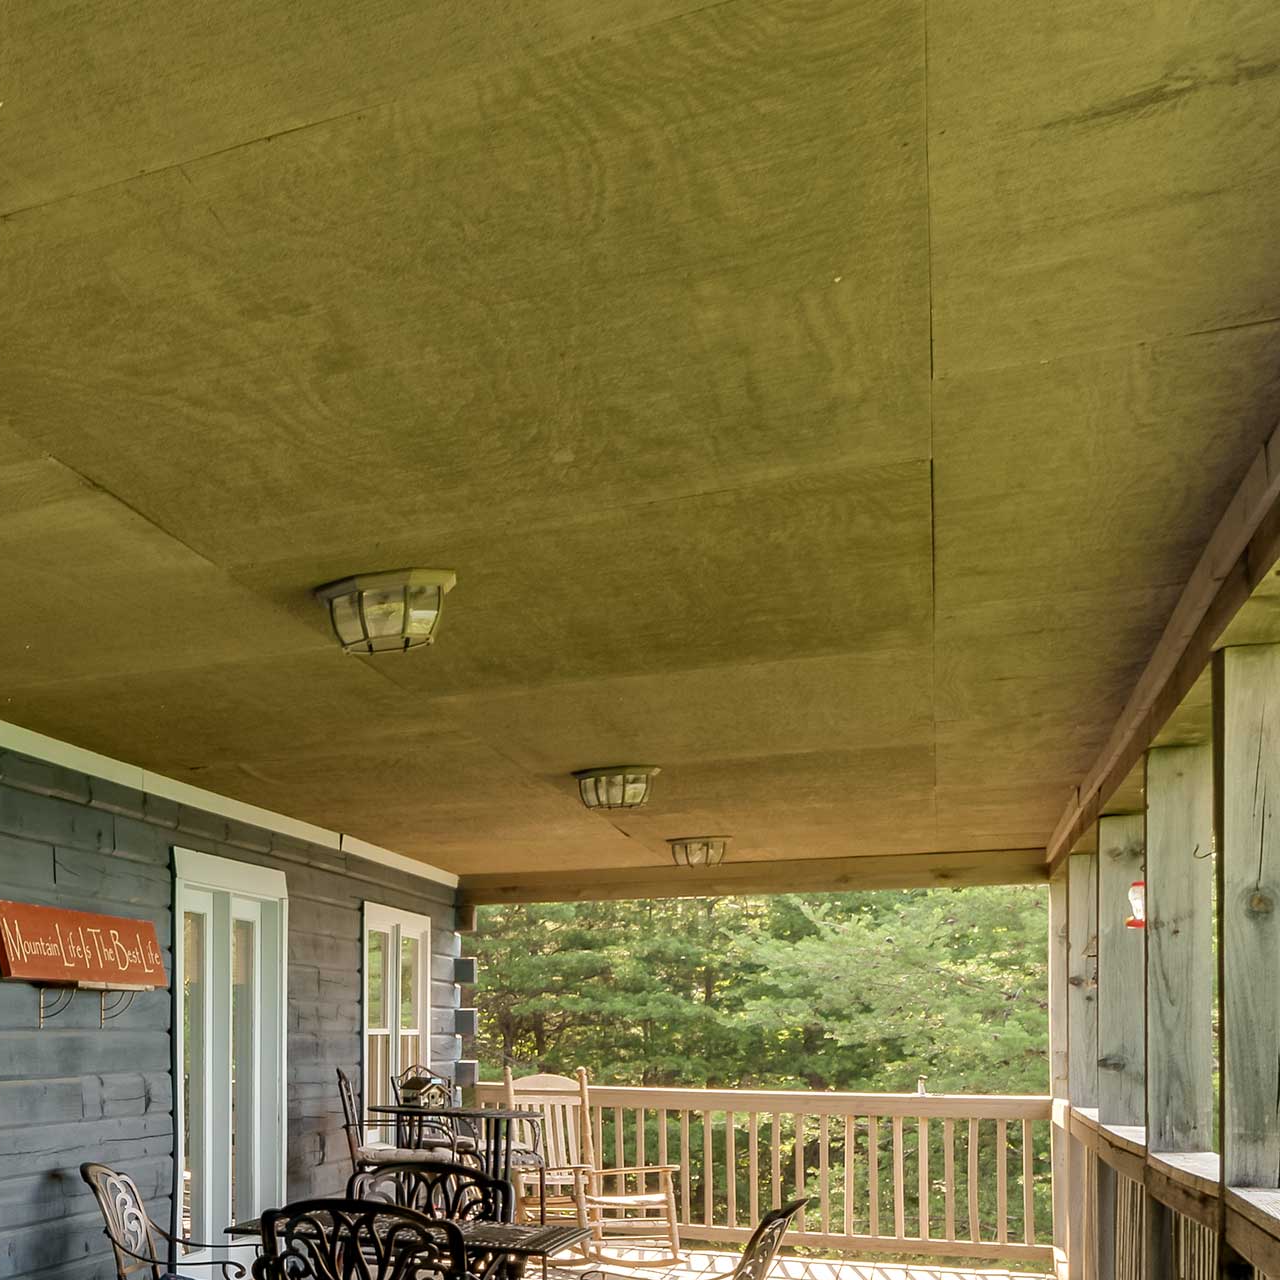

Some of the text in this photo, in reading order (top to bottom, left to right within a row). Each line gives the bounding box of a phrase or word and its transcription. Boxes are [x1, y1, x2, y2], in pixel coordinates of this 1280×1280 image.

[3, 918, 160, 972] Mountain Life Is The Best Life
